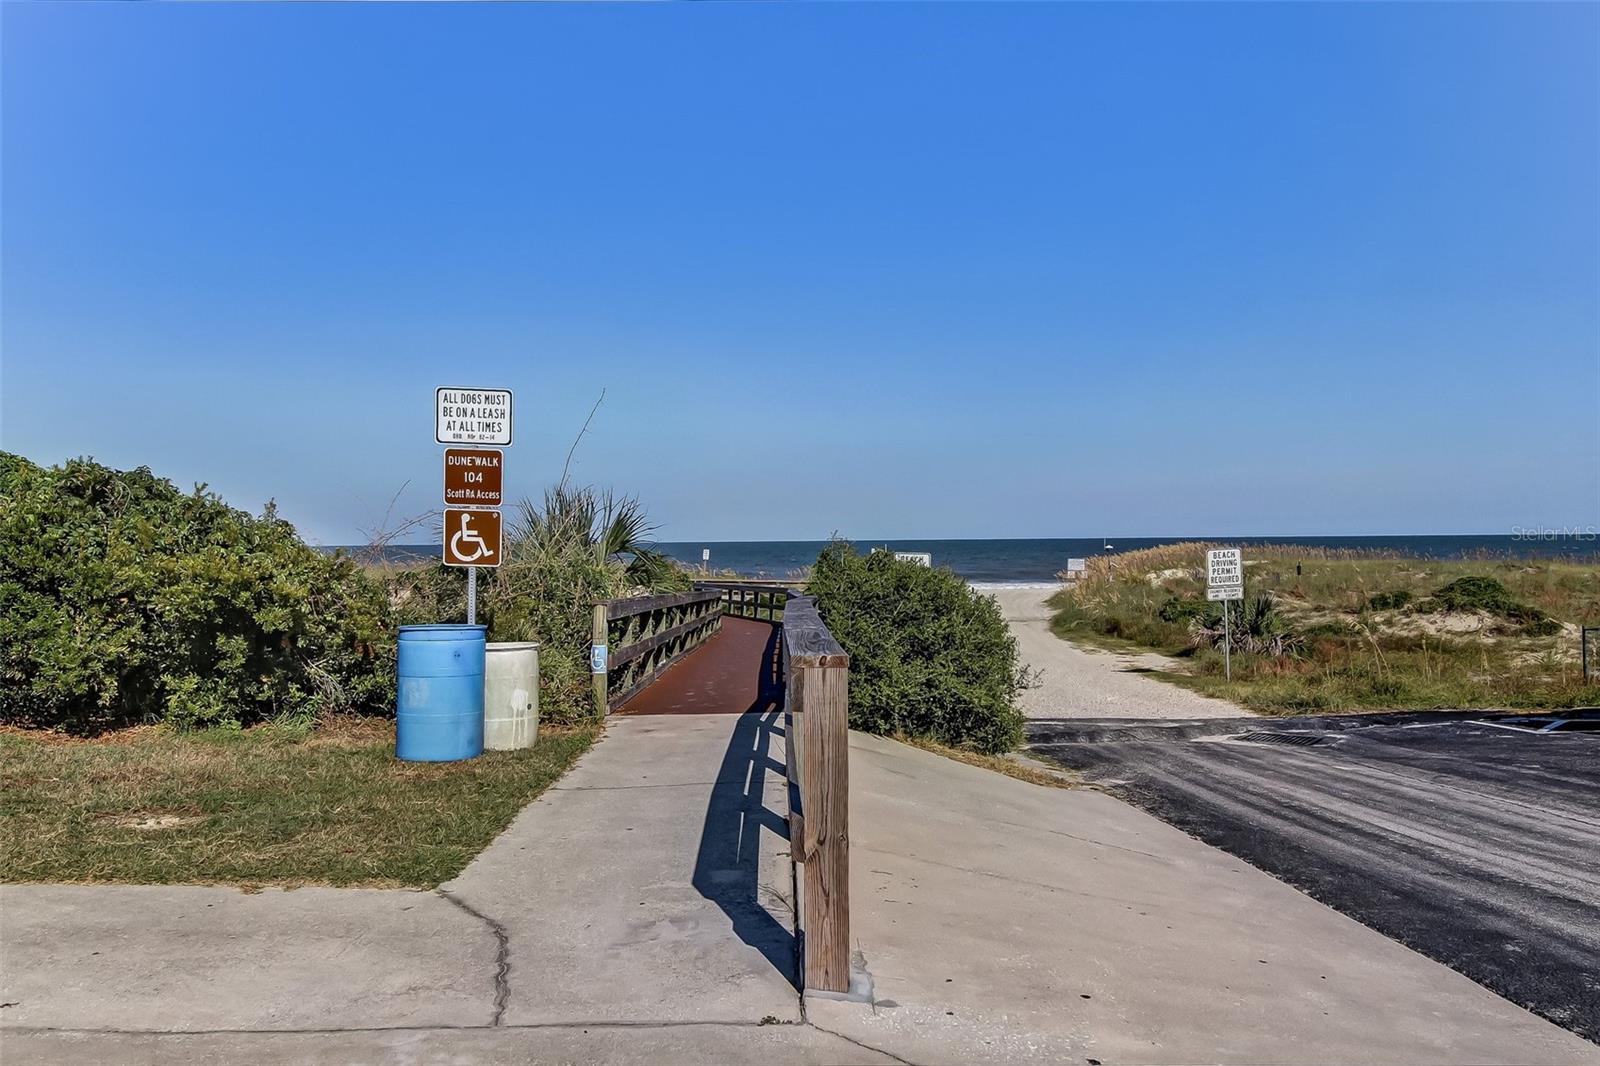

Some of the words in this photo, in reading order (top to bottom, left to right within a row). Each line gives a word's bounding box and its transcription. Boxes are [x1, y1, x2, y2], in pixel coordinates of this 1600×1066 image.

[443, 393, 458, 404] ALL
[461, 393, 482, 405] DOGS
[484, 394, 506, 405] MUST
[443, 406, 453, 417] BE
[456, 407, 467, 418] ON
[470, 408, 475, 418] A
[478, 408, 505, 419] LEASH
[446, 420, 456, 431] AT
[459, 421, 475, 432] ALL
[477, 421, 502, 432] TIMES
[464, 471, 483, 483] 104
[446, 488, 465, 498] Scott
[476, 490, 500, 499] Access
[1213, 551, 1236, 559] BEACH
[1211, 559, 1238, 567] DRIVING
[1212, 567, 1237, 575] PERMIT
[1210, 575, 1239, 583] REQUIRED
